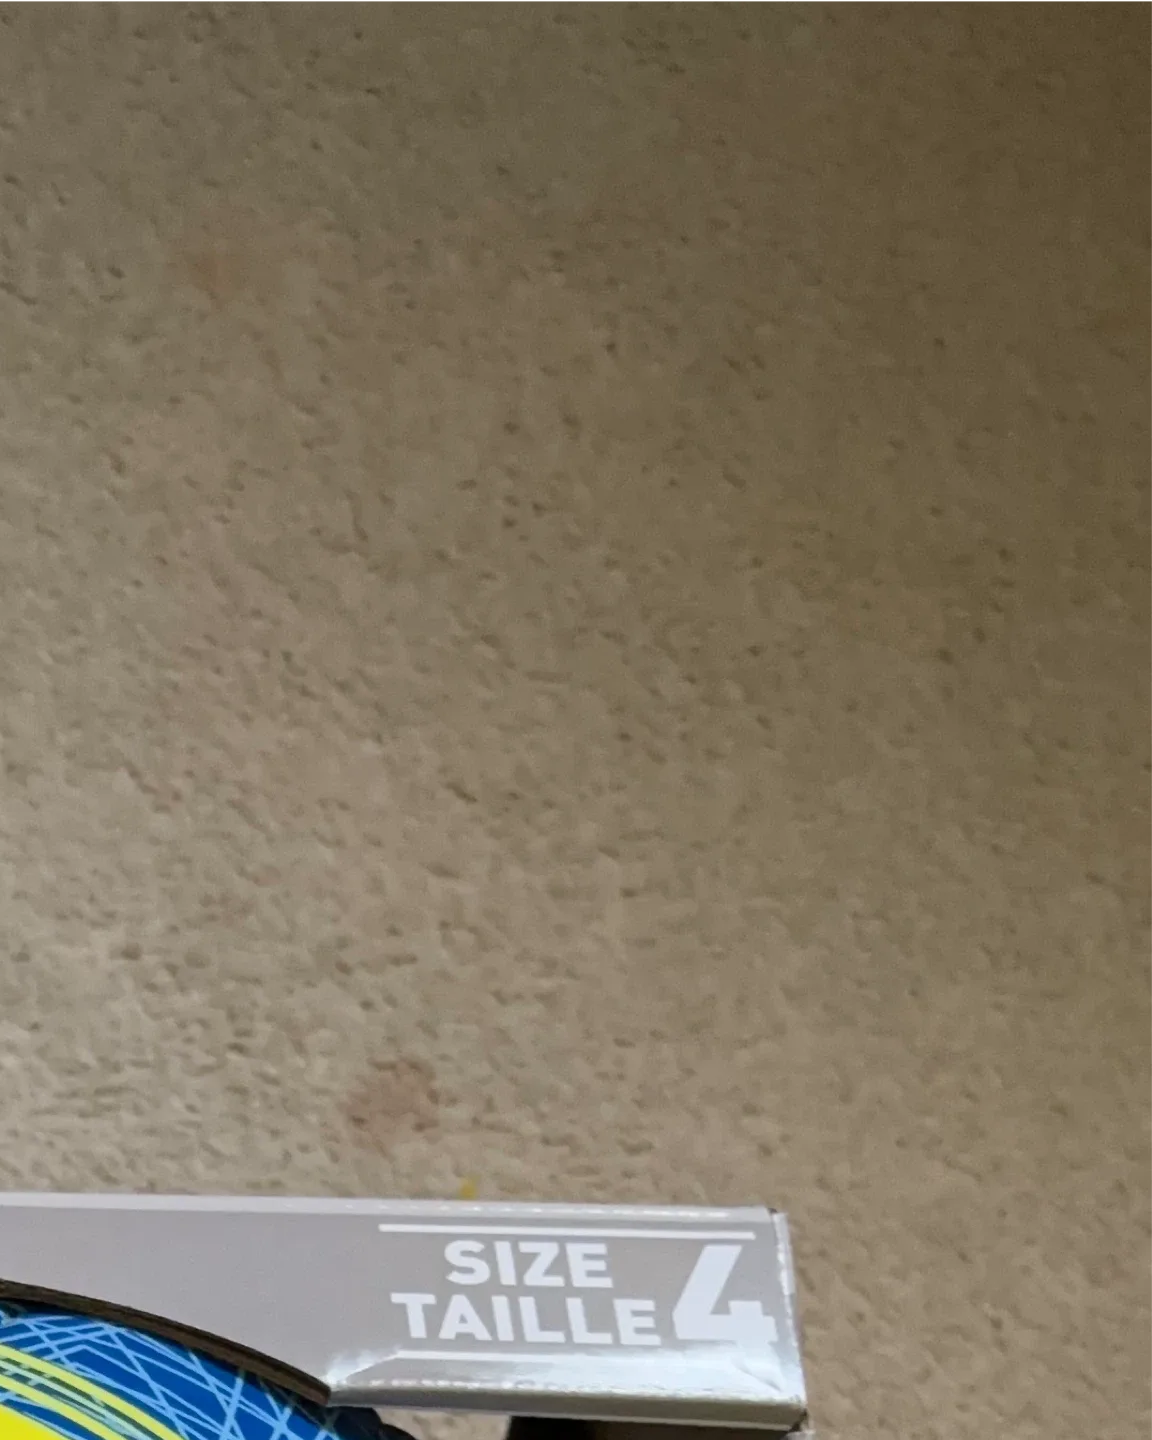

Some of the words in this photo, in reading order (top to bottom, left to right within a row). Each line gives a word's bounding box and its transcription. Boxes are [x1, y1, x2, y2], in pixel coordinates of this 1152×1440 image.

[444, 1239, 614, 1289] SIZE
[391, 1291, 662, 1346] TAILLE
[671, 1243, 780, 1352] 4
